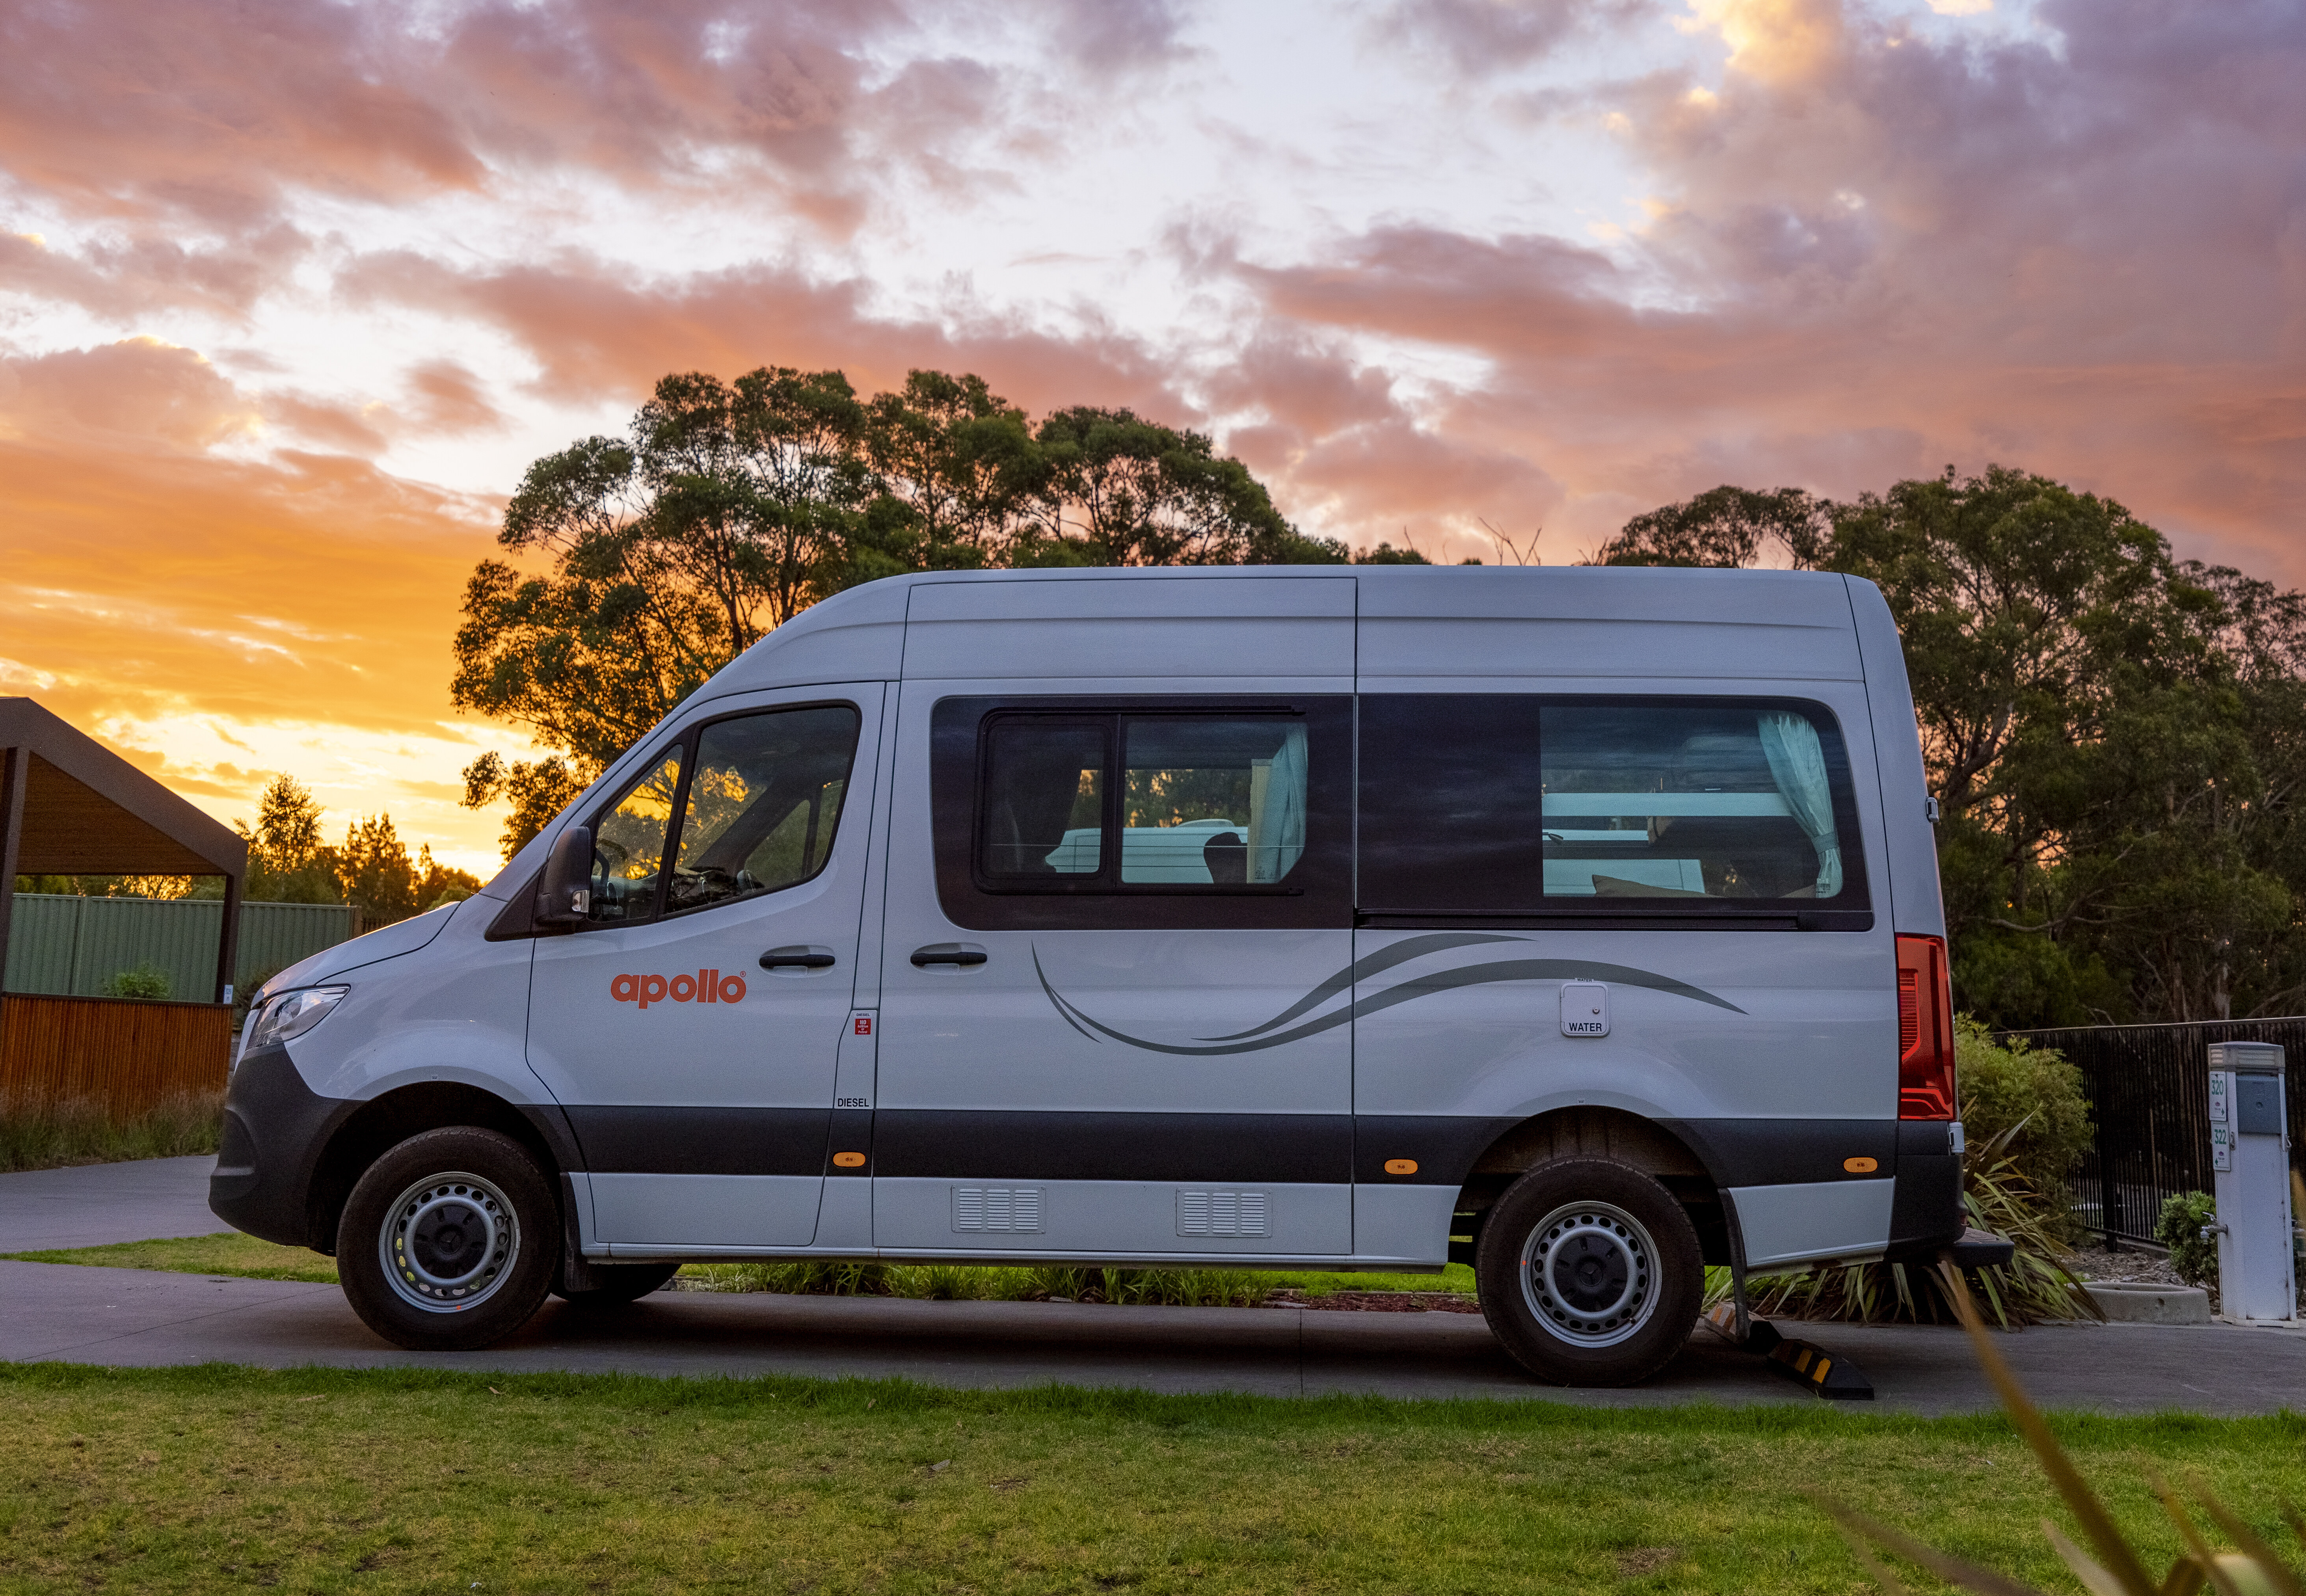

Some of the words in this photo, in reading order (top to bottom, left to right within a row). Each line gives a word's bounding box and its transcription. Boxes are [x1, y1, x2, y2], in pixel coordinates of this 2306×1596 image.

[1569, 1023, 1602, 1031] WATER
[2211, 1080, 2224, 1095] 320
[838, 1098, 869, 1107] DIESEL
[2215, 1129, 2227, 1144] 322
